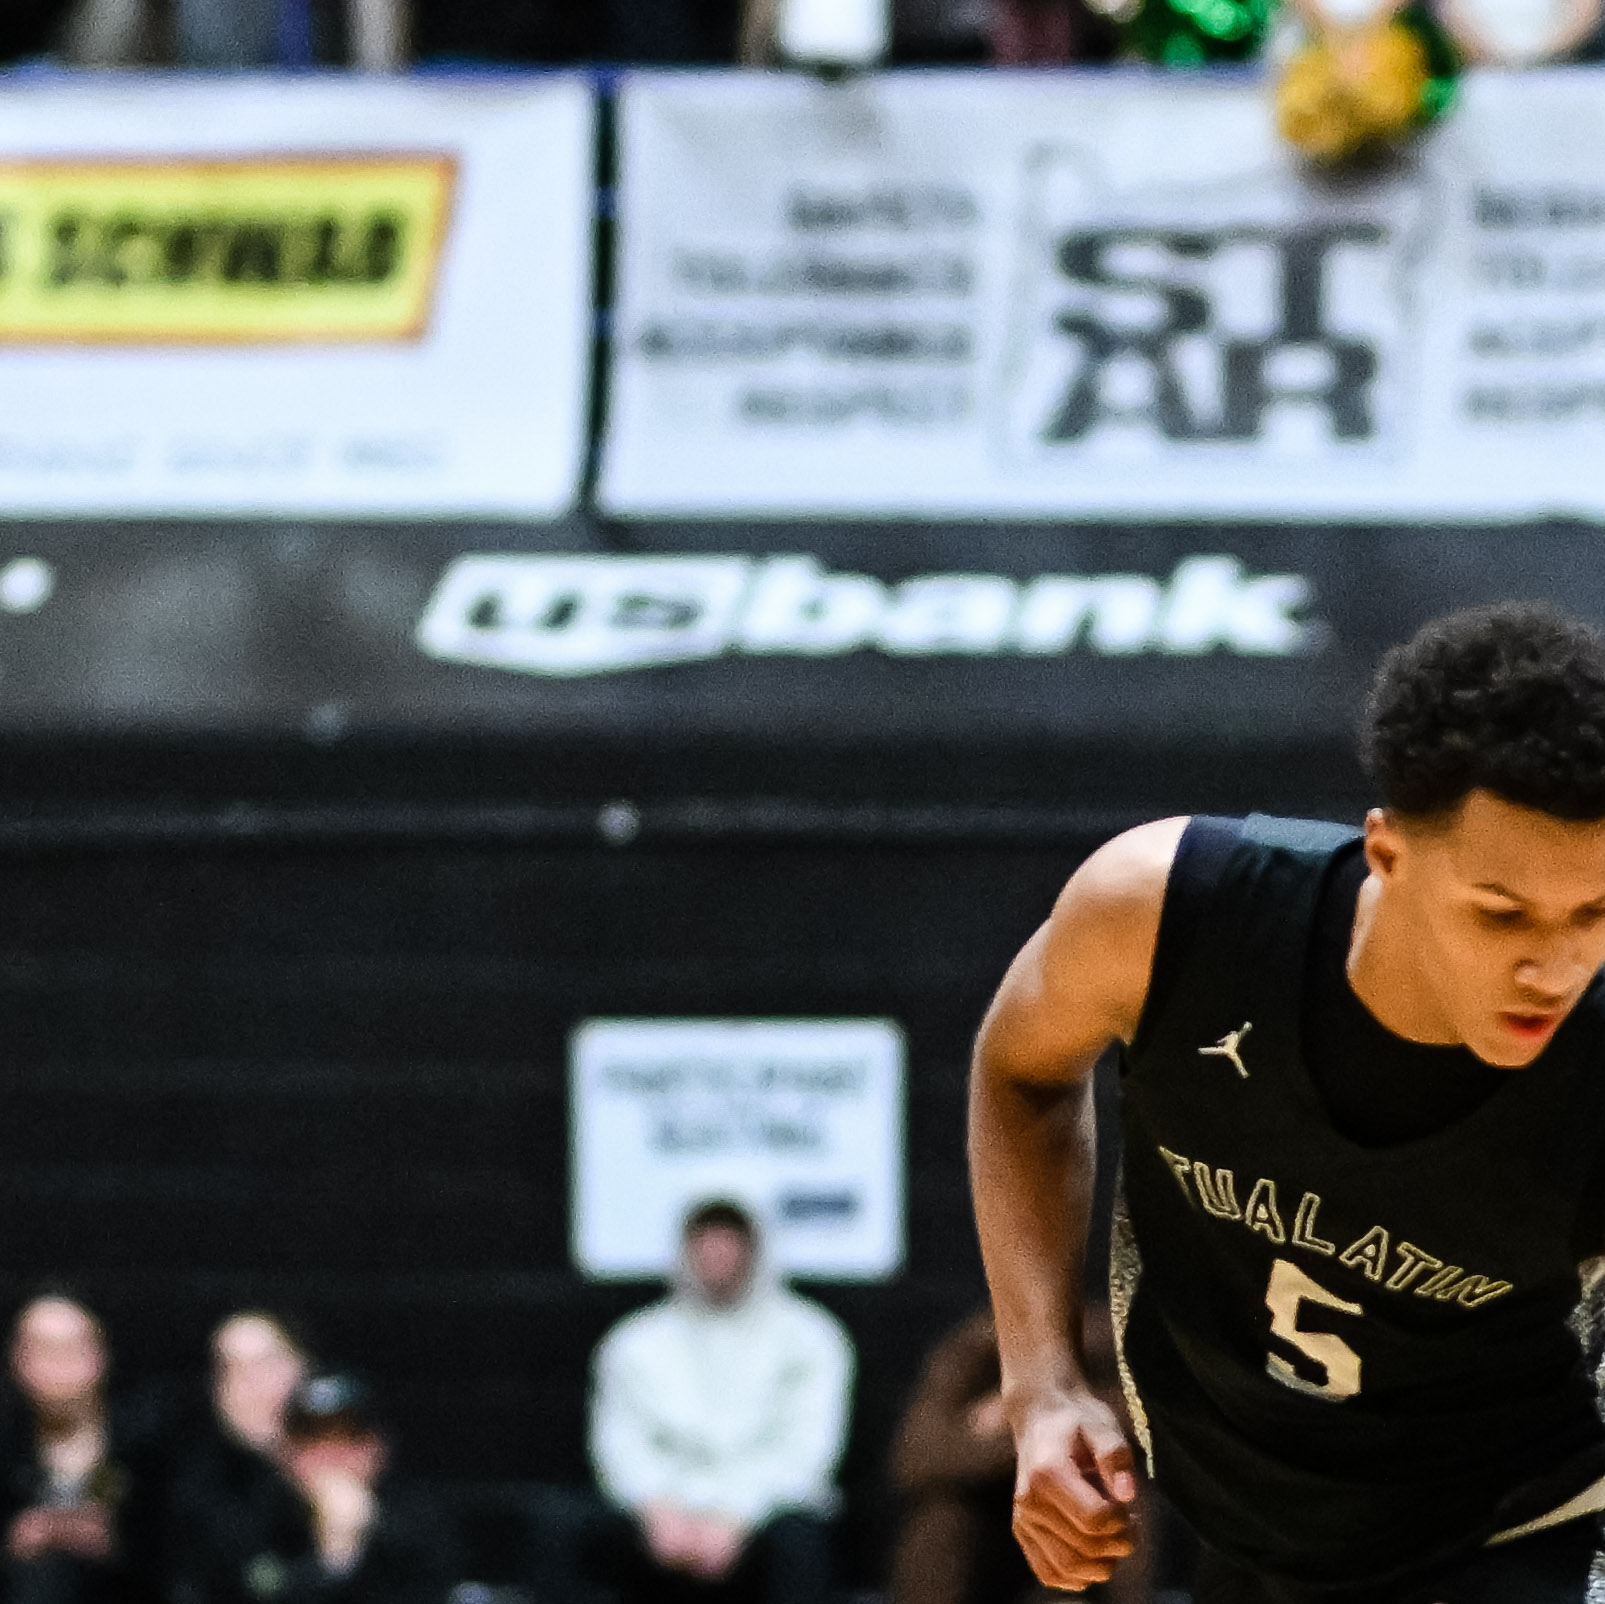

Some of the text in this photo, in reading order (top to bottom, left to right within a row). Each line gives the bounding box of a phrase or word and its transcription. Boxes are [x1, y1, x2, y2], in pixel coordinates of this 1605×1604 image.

[46, 208, 412, 290] SCHWAB
[1156, 1142, 1516, 1310] TUALATIN
[1262, 1256, 1366, 1403] 5
